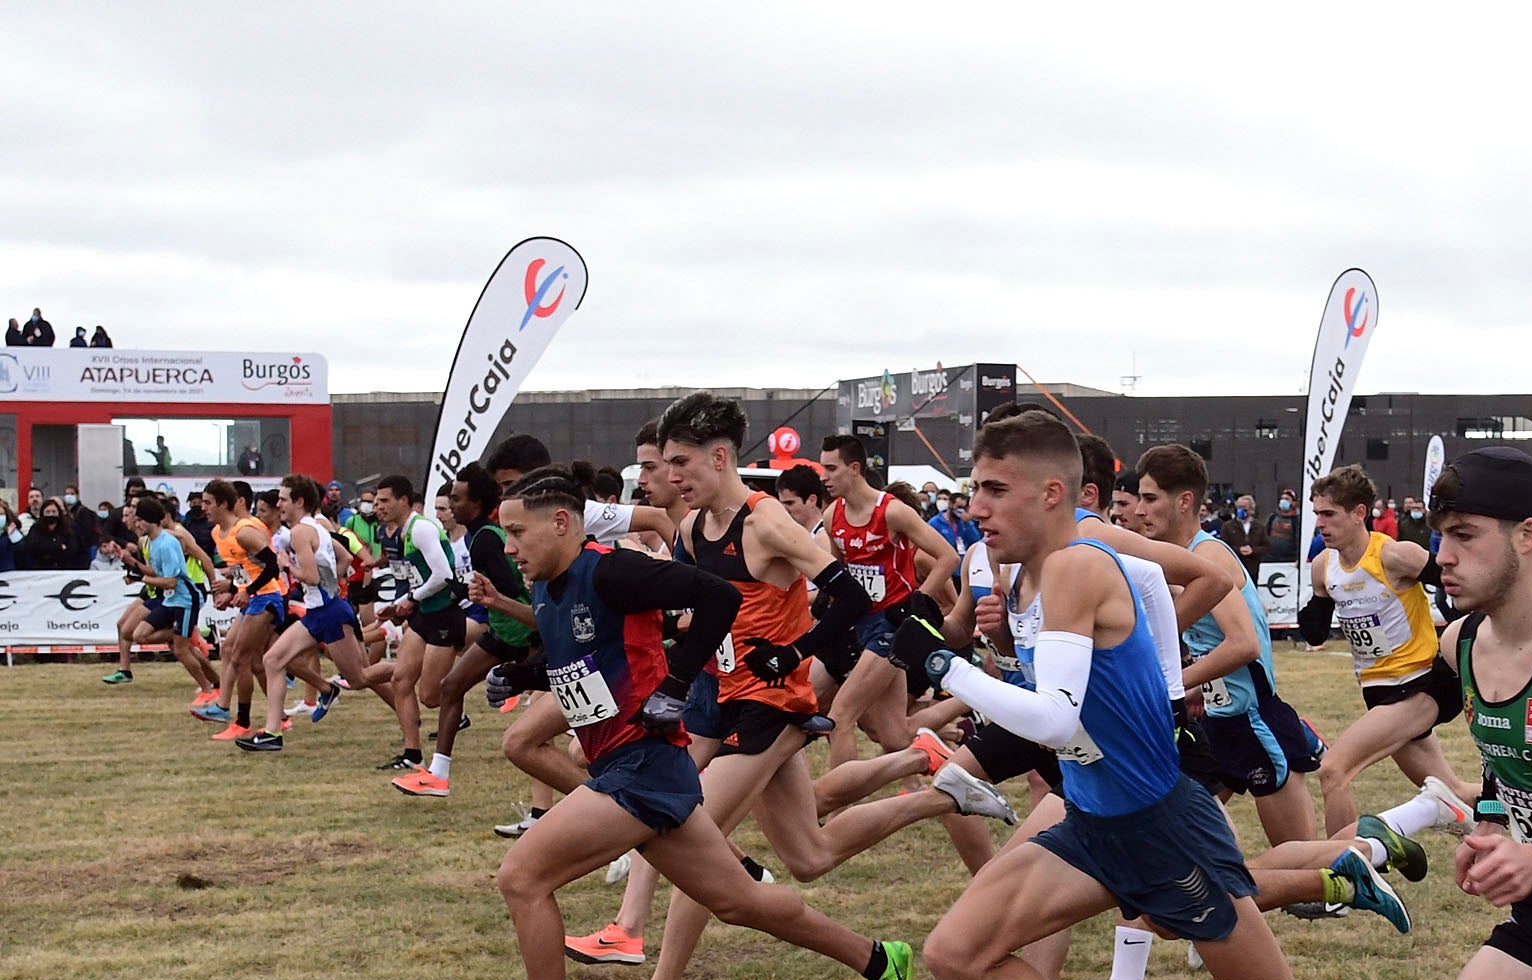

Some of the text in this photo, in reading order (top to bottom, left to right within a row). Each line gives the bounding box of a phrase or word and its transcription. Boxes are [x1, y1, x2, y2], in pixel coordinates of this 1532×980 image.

[112, 356, 139, 365] Cross
[142, 356, 203, 366] Internacional
[80, 367, 214, 385] ATAPUERCA
[243, 358, 310, 386] Burgos
[1306, 356, 1346, 481] iberCaja
[47, 620, 100, 631] iberCaja
[1344, 629, 1374, 647] 599
[556, 681, 592, 711] 611
